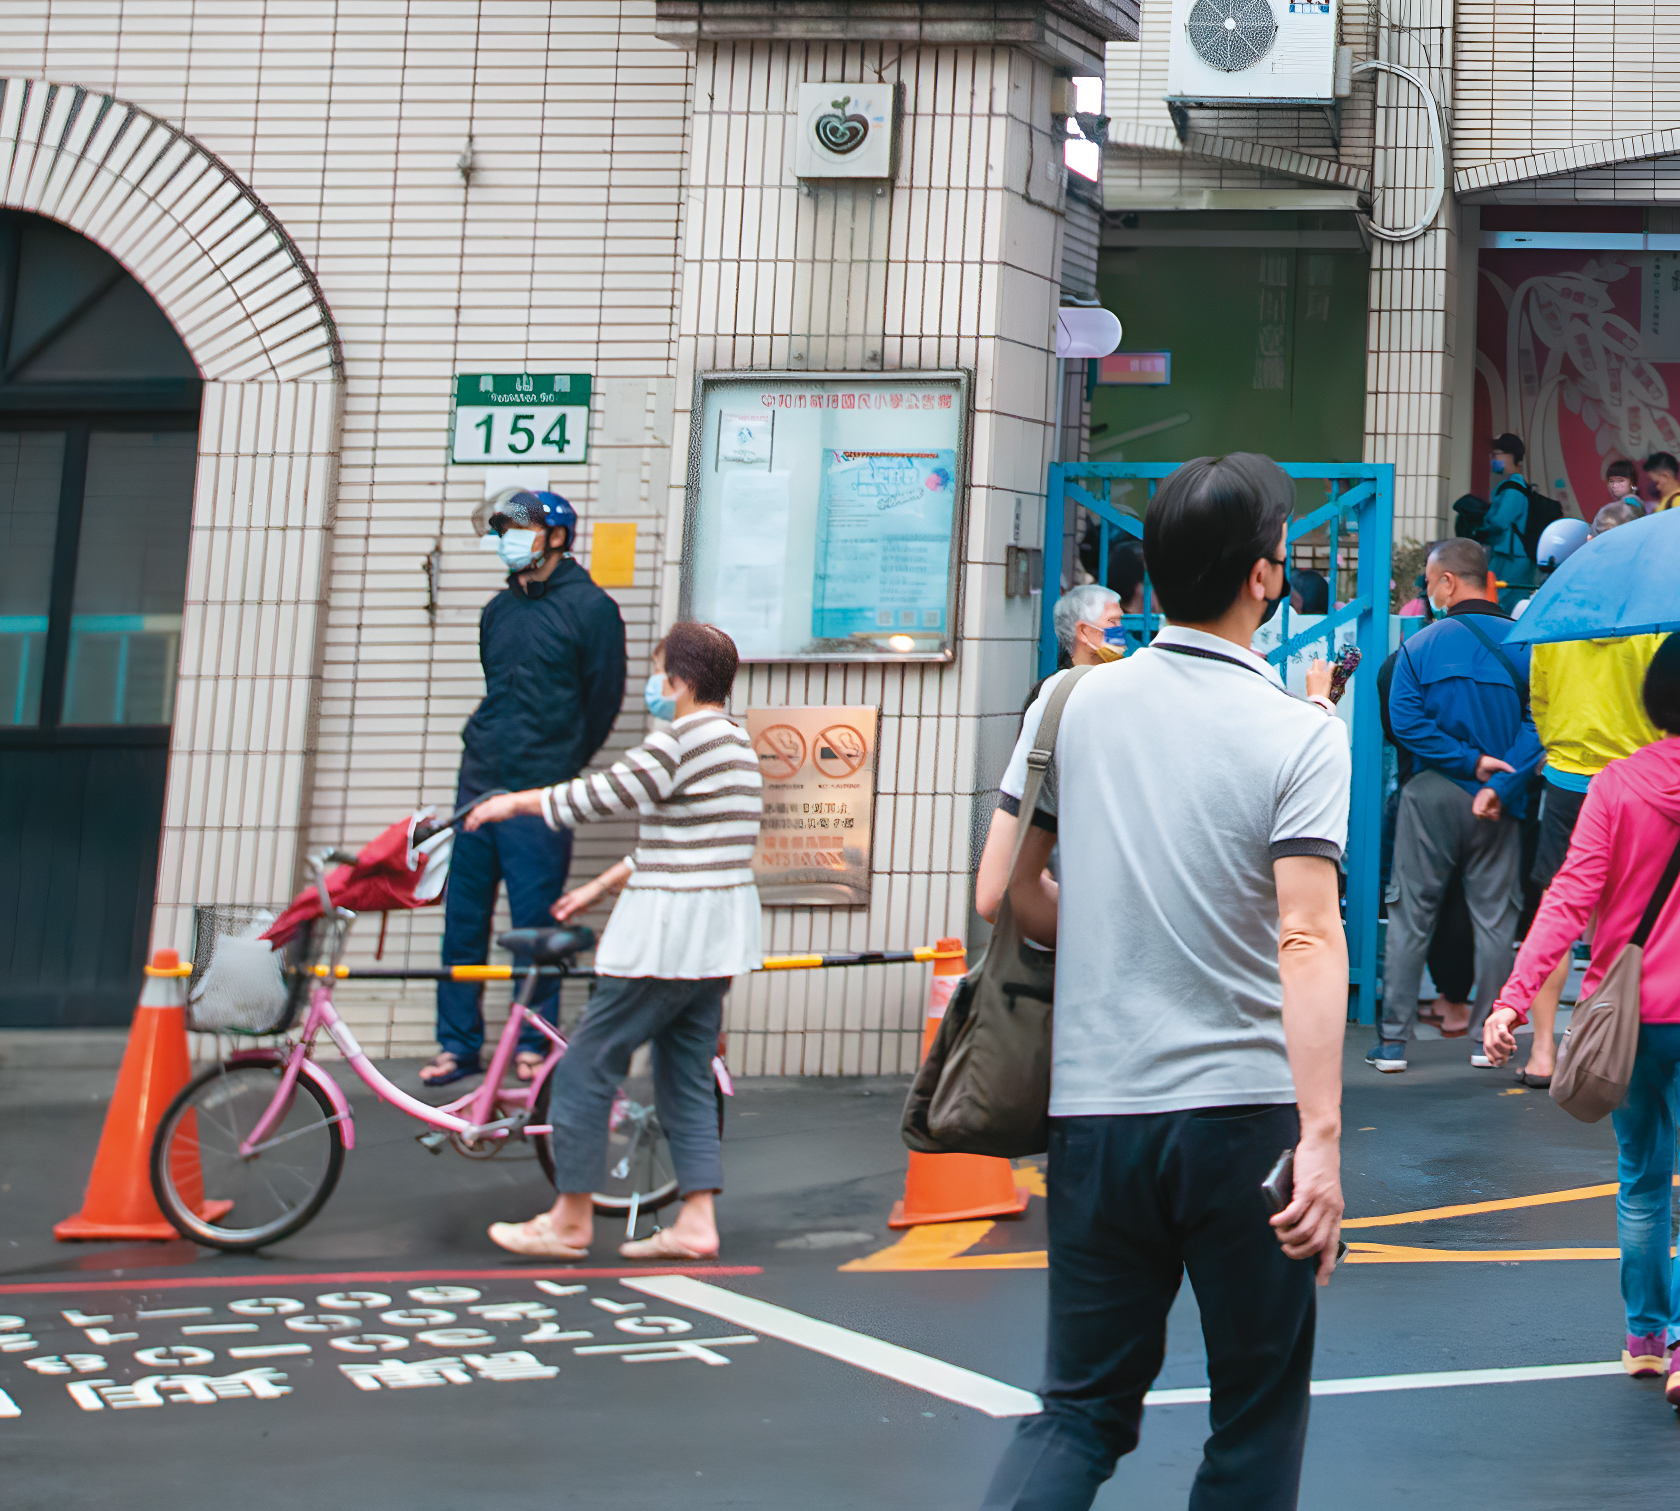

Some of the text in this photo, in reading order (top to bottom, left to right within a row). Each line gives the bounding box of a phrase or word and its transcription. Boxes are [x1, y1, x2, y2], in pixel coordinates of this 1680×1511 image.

[475, 412, 571, 455] 154
[0, 1333, 760, 1419] 上課期
